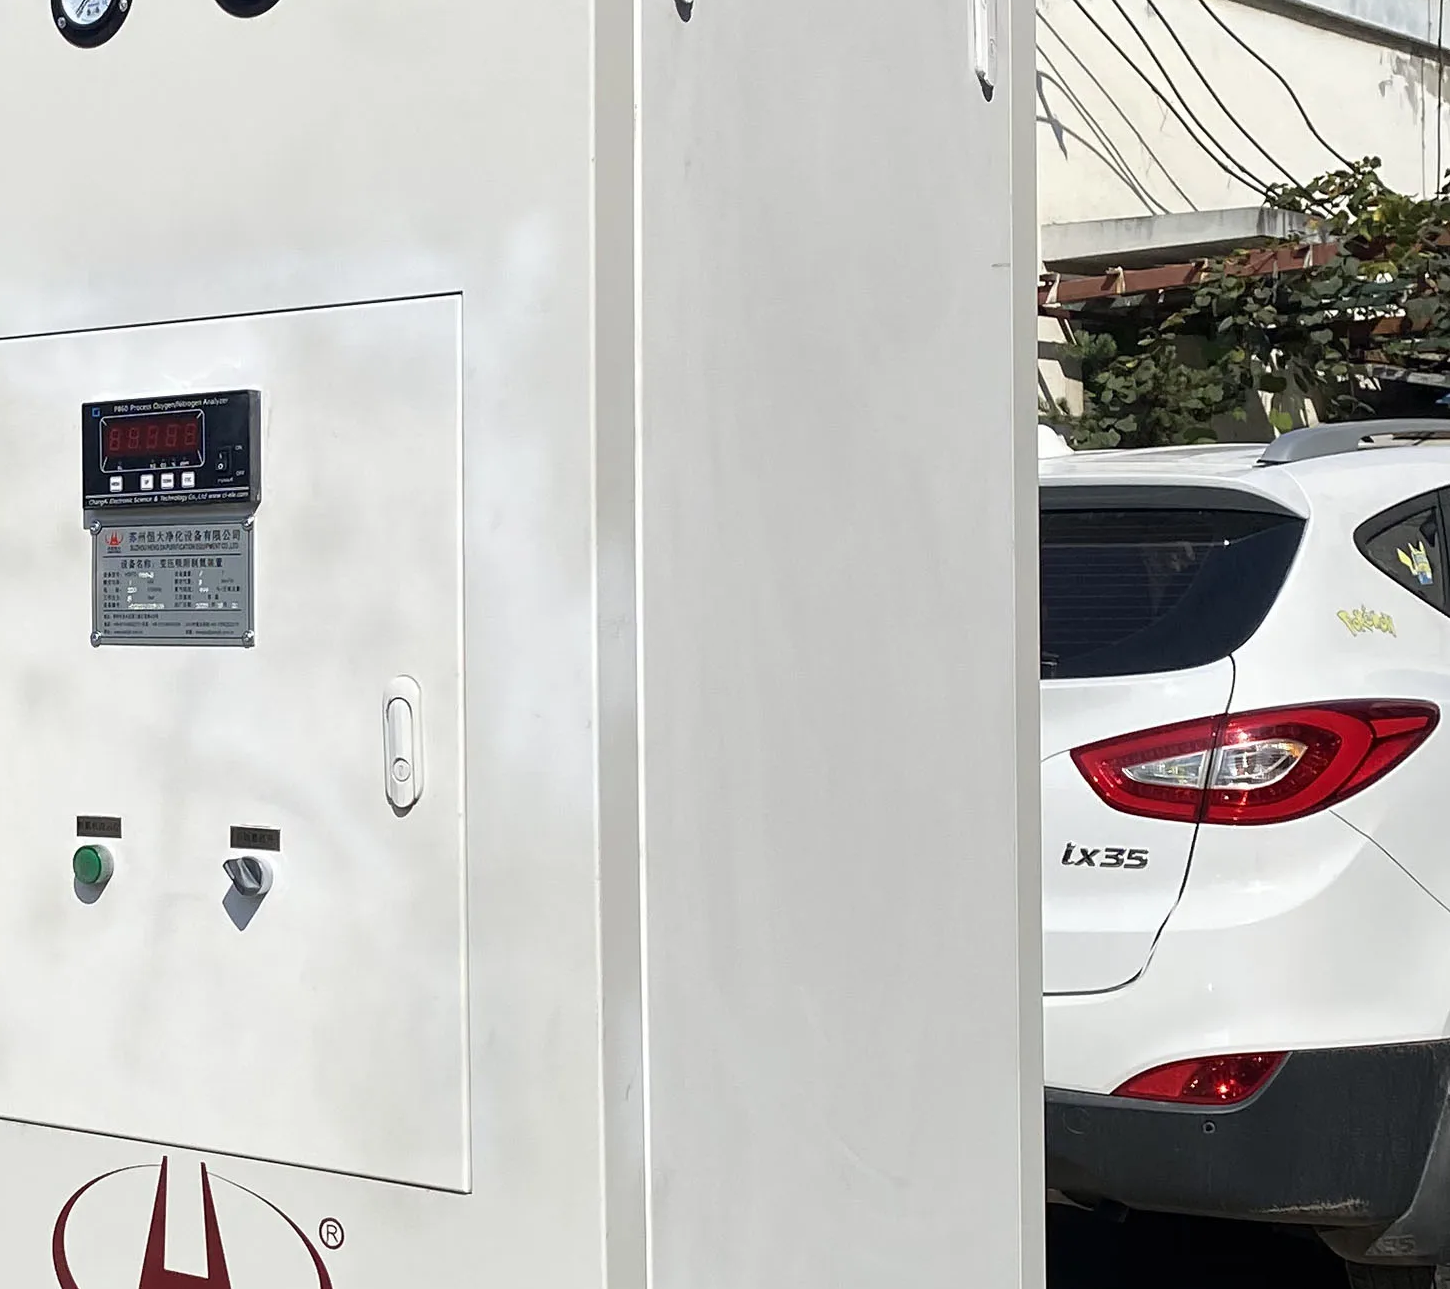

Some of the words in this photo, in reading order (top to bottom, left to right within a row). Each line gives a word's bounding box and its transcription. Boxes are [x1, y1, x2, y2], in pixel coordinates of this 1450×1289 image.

[203, 397, 229, 406] Analyzer
[160, 494, 187, 502] Technology
[1061, 841, 1149, 869] ix35
